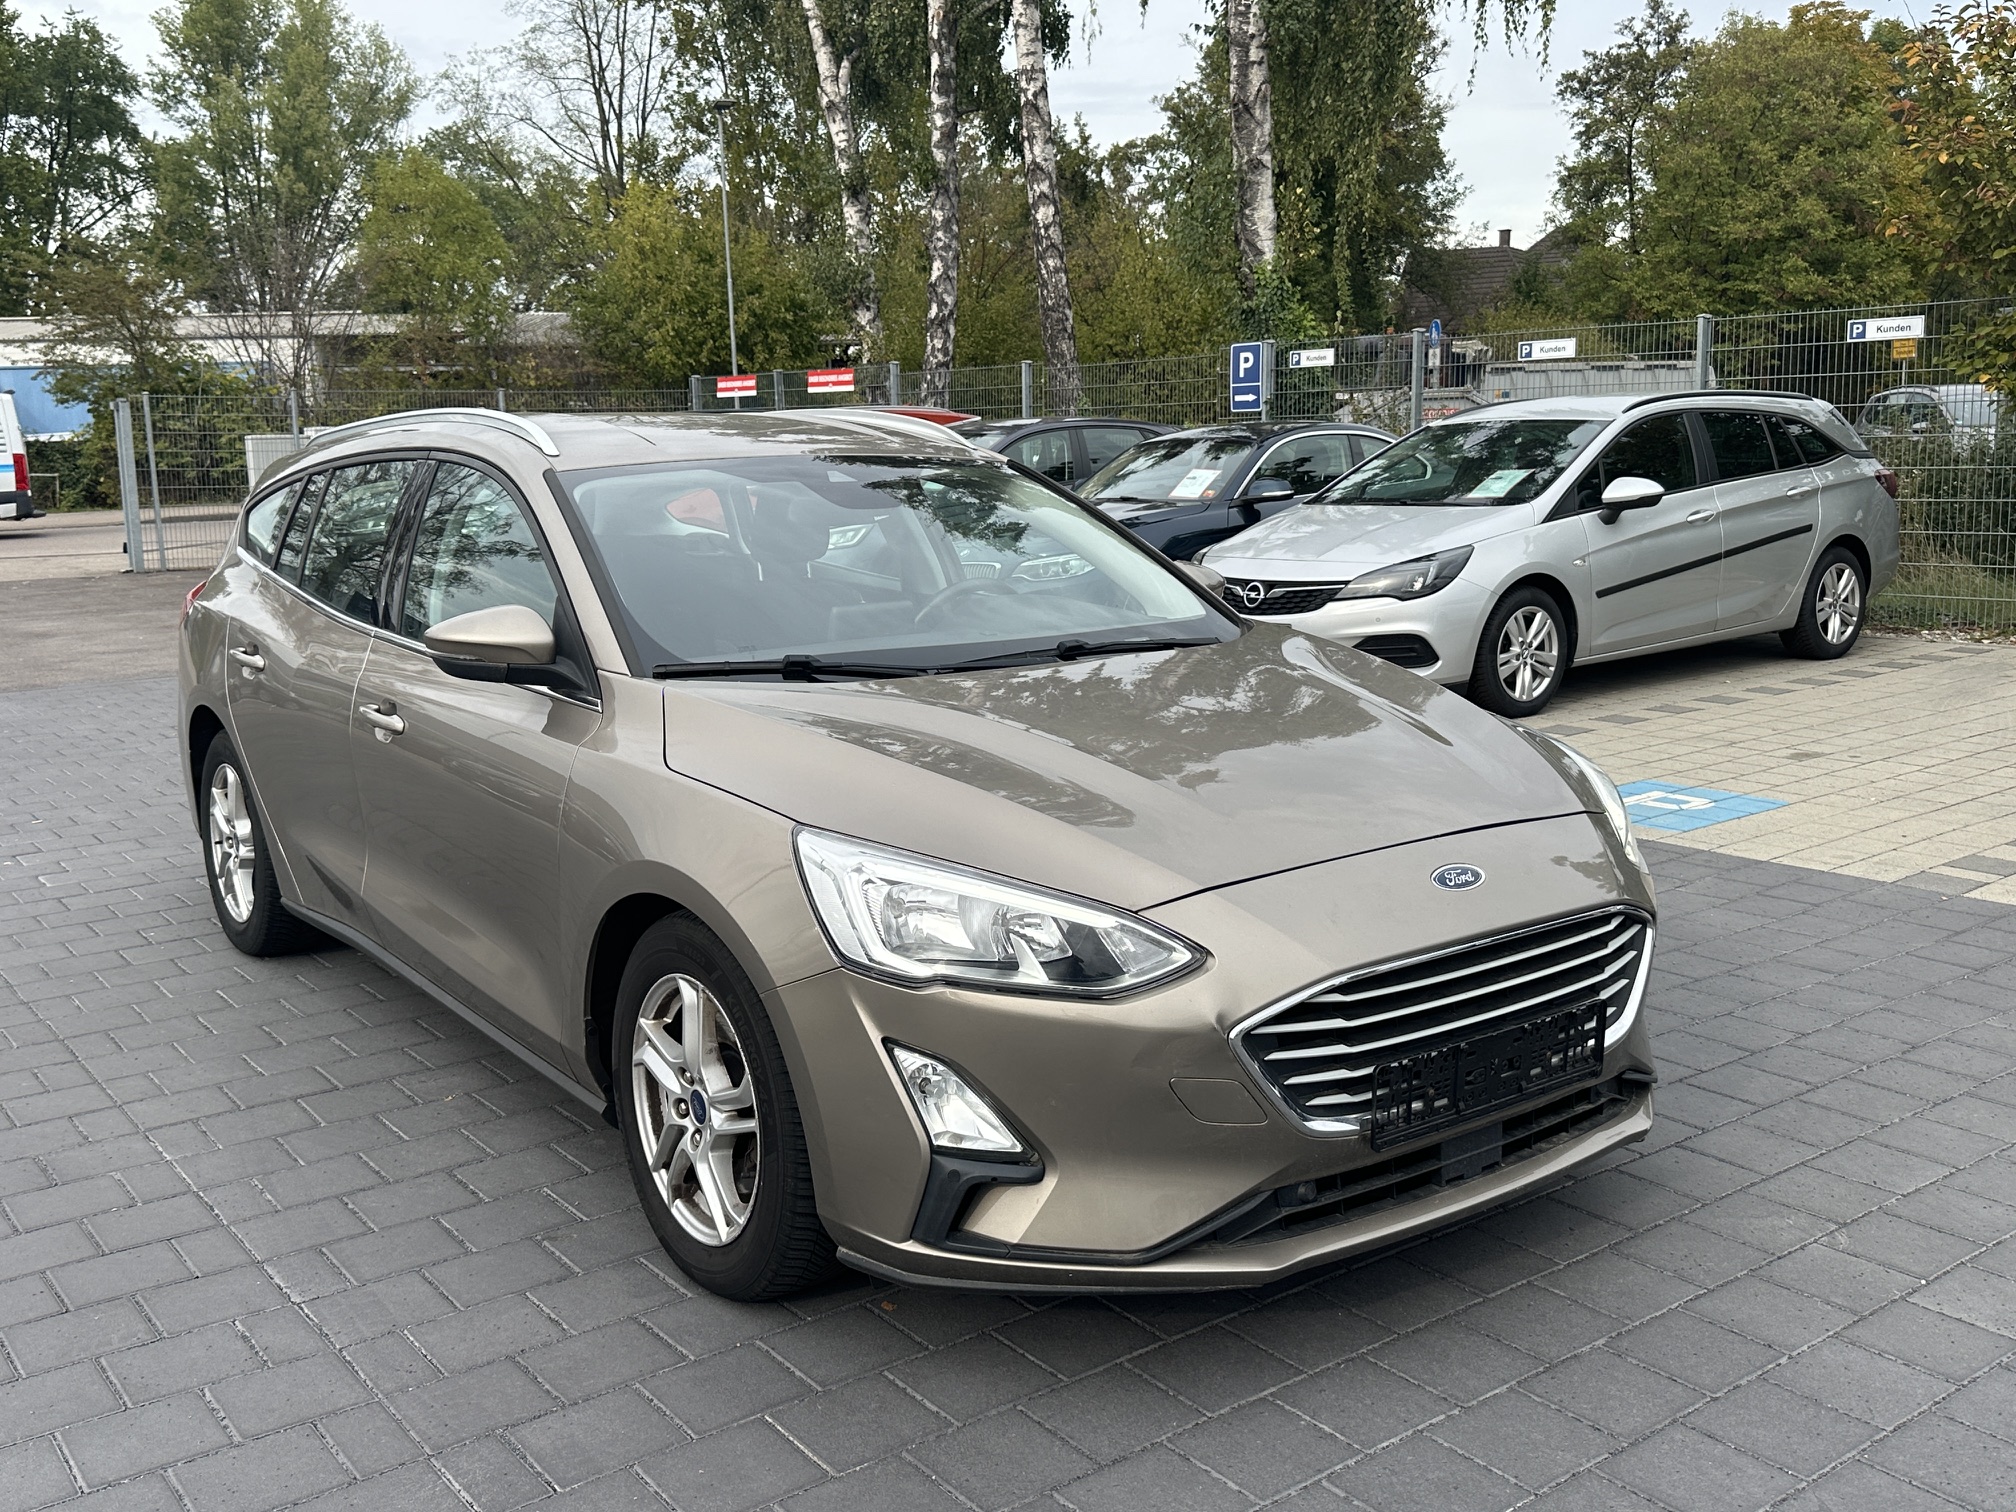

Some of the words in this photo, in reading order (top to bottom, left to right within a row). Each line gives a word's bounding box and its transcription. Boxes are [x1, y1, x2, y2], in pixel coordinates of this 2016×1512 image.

[1852, 324, 1863, 338] P
[1876, 324, 1912, 333] Kunden
[1522, 345, 1530, 358] P
[1239, 352, 1254, 378] P
[1292, 354, 1299, 365] P
[1444, 869, 1475, 886] Ford
